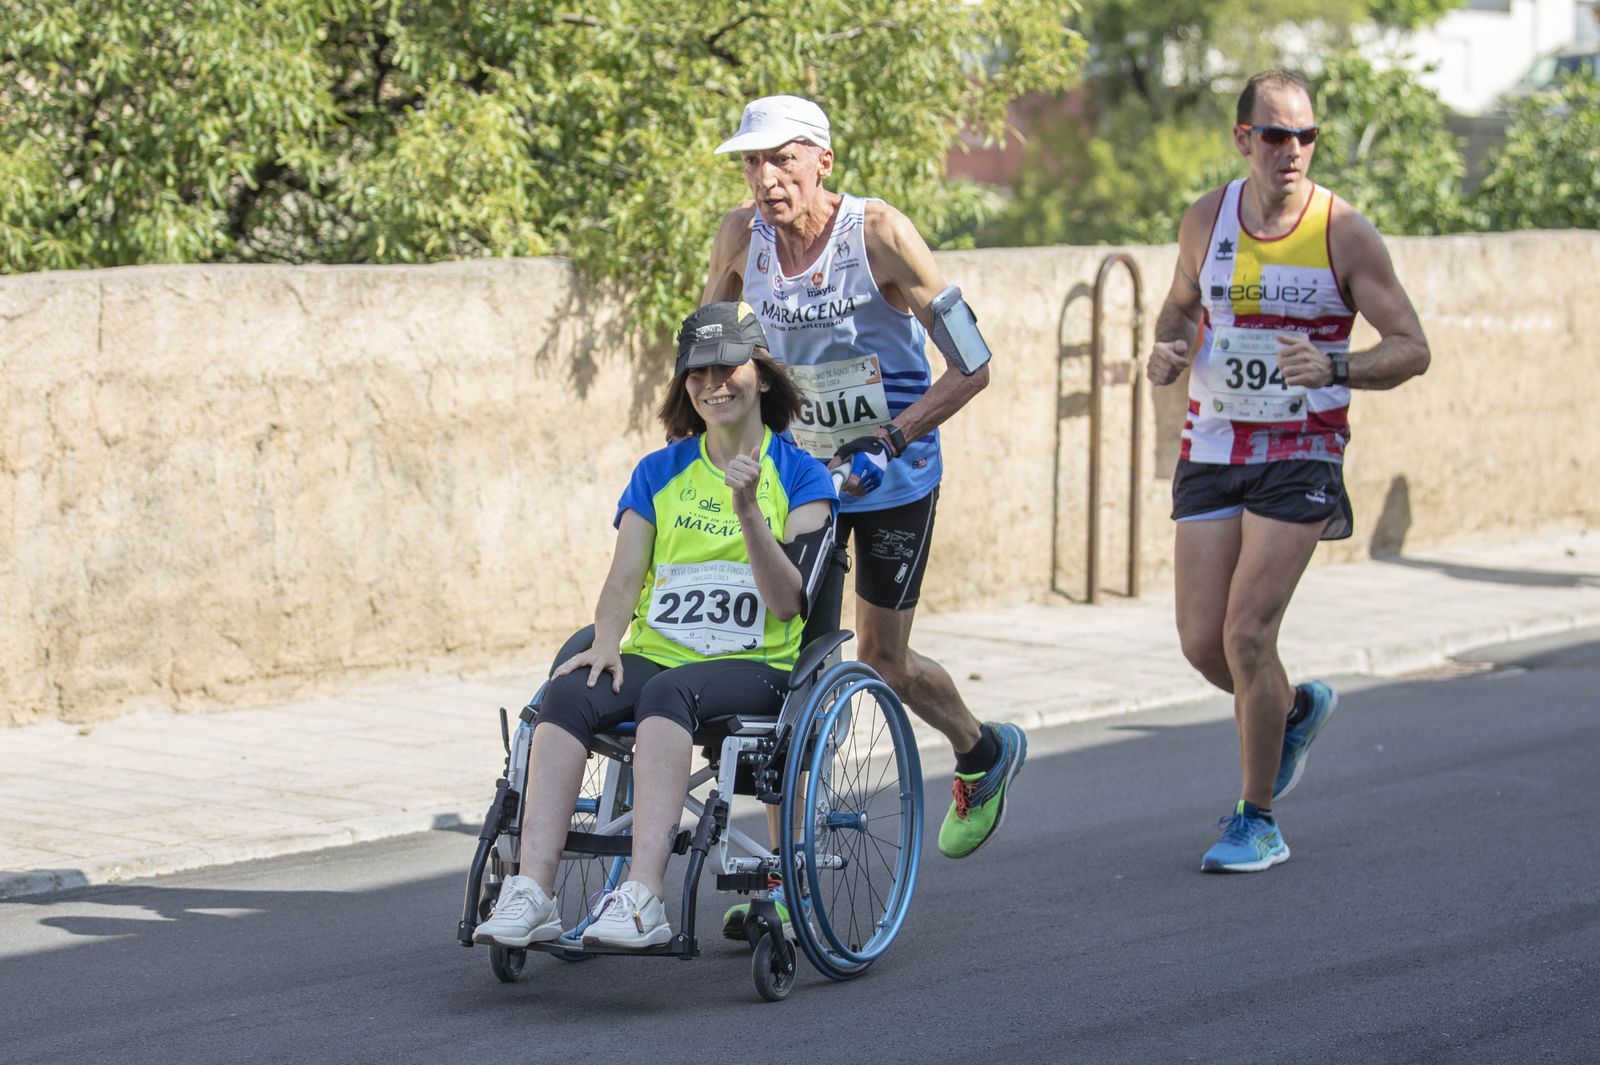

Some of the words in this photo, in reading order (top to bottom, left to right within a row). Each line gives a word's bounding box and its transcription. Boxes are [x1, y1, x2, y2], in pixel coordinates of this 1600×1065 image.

[761, 297, 856, 324] MARACENA
[788, 324, 798, 332] DE
[800, 318, 844, 330] ATLETISMO
[1225, 357, 1288, 390] 394
[800, 391, 878, 428] GUÍA
[654, 588, 759, 628] 2230
